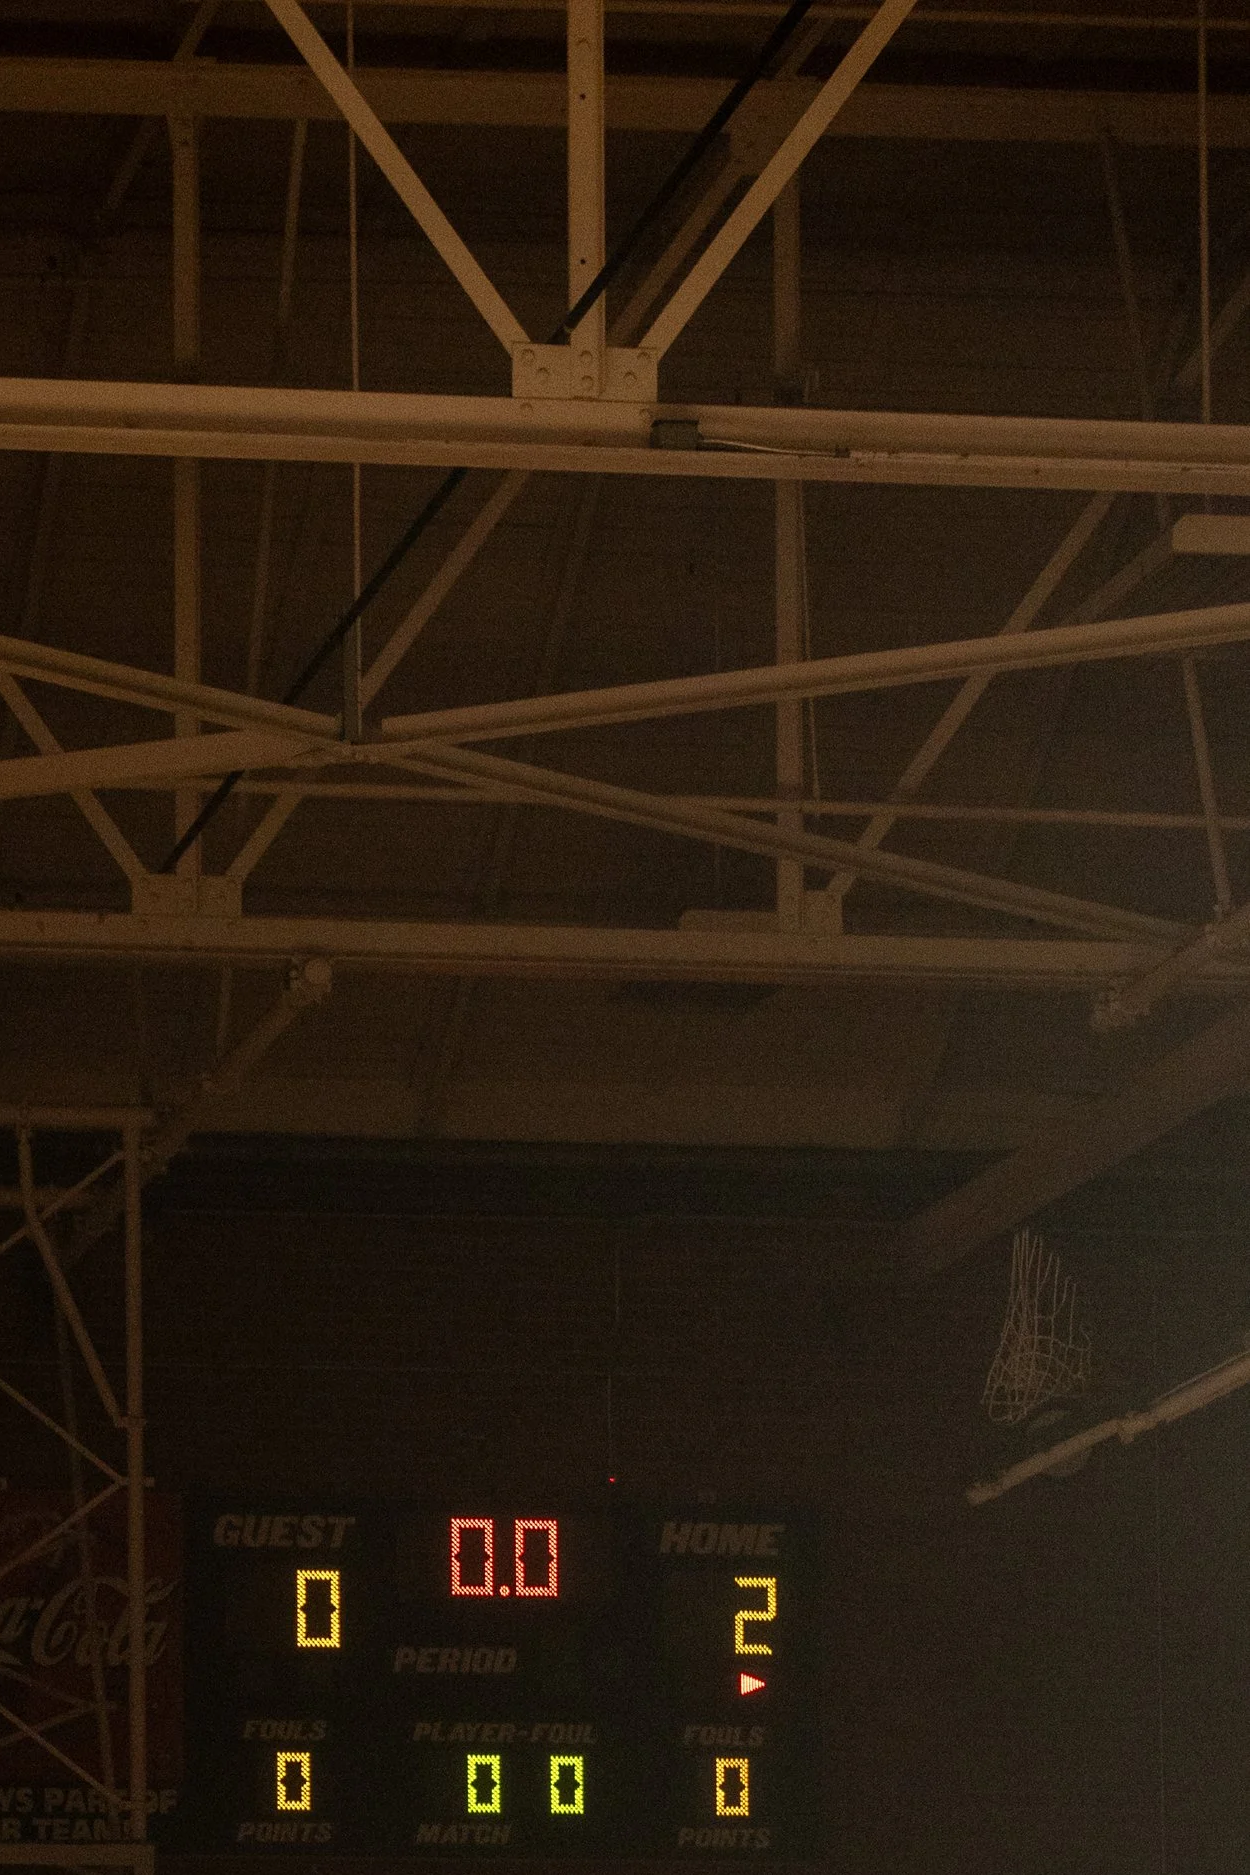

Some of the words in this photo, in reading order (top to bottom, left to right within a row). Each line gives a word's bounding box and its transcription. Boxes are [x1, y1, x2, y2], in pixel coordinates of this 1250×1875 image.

[212, 1513, 357, 1550] GUEST
[659, 1521, 785, 1557] HOME
[450, 1517, 559, 1598] 0.0
[296, 1569, 341, 1649] 0
[734, 1576, 778, 1655] 2
[393, 1646, 518, 1675] PERIOD
[242, 1719, 328, 1742] FOULS
[413, 1721, 599, 1744] PLAYER-FOUL
[682, 1724, 766, 1747] FOULS
[276, 1751, 312, 1811] 0
[466, 1753, 502, 1814] 0
[549, 1754, 585, 1815] 0
[714, 1757, 750, 1817] 0
[236, 1821, 333, 1844] POINTS
[415, 1823, 513, 1845] MATCH
[677, 1827, 771, 1850] POINTS
